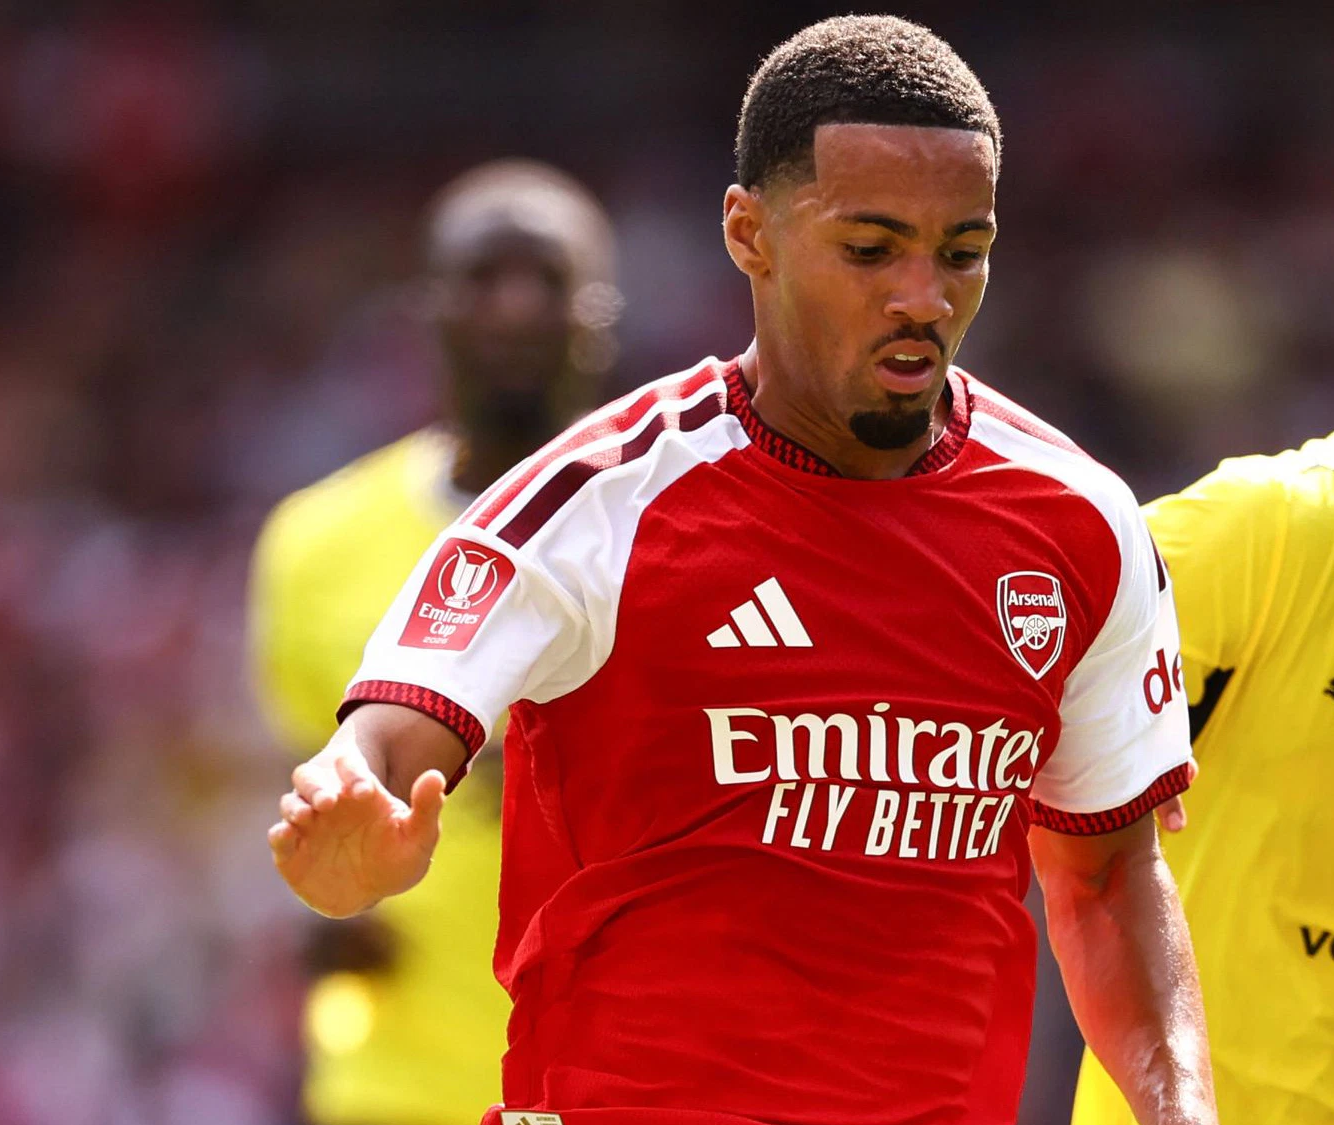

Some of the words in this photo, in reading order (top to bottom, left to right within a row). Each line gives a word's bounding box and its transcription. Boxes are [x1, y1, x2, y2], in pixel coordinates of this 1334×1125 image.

[1007, 590, 1058, 607] Arsenal
[418, 602, 481, 625] Emirates
[429, 621, 457, 637] Cup
[702, 702, 1045, 792] Emirates
[761, 781, 857, 851] FLY
[864, 789, 1016, 861] BETTER
